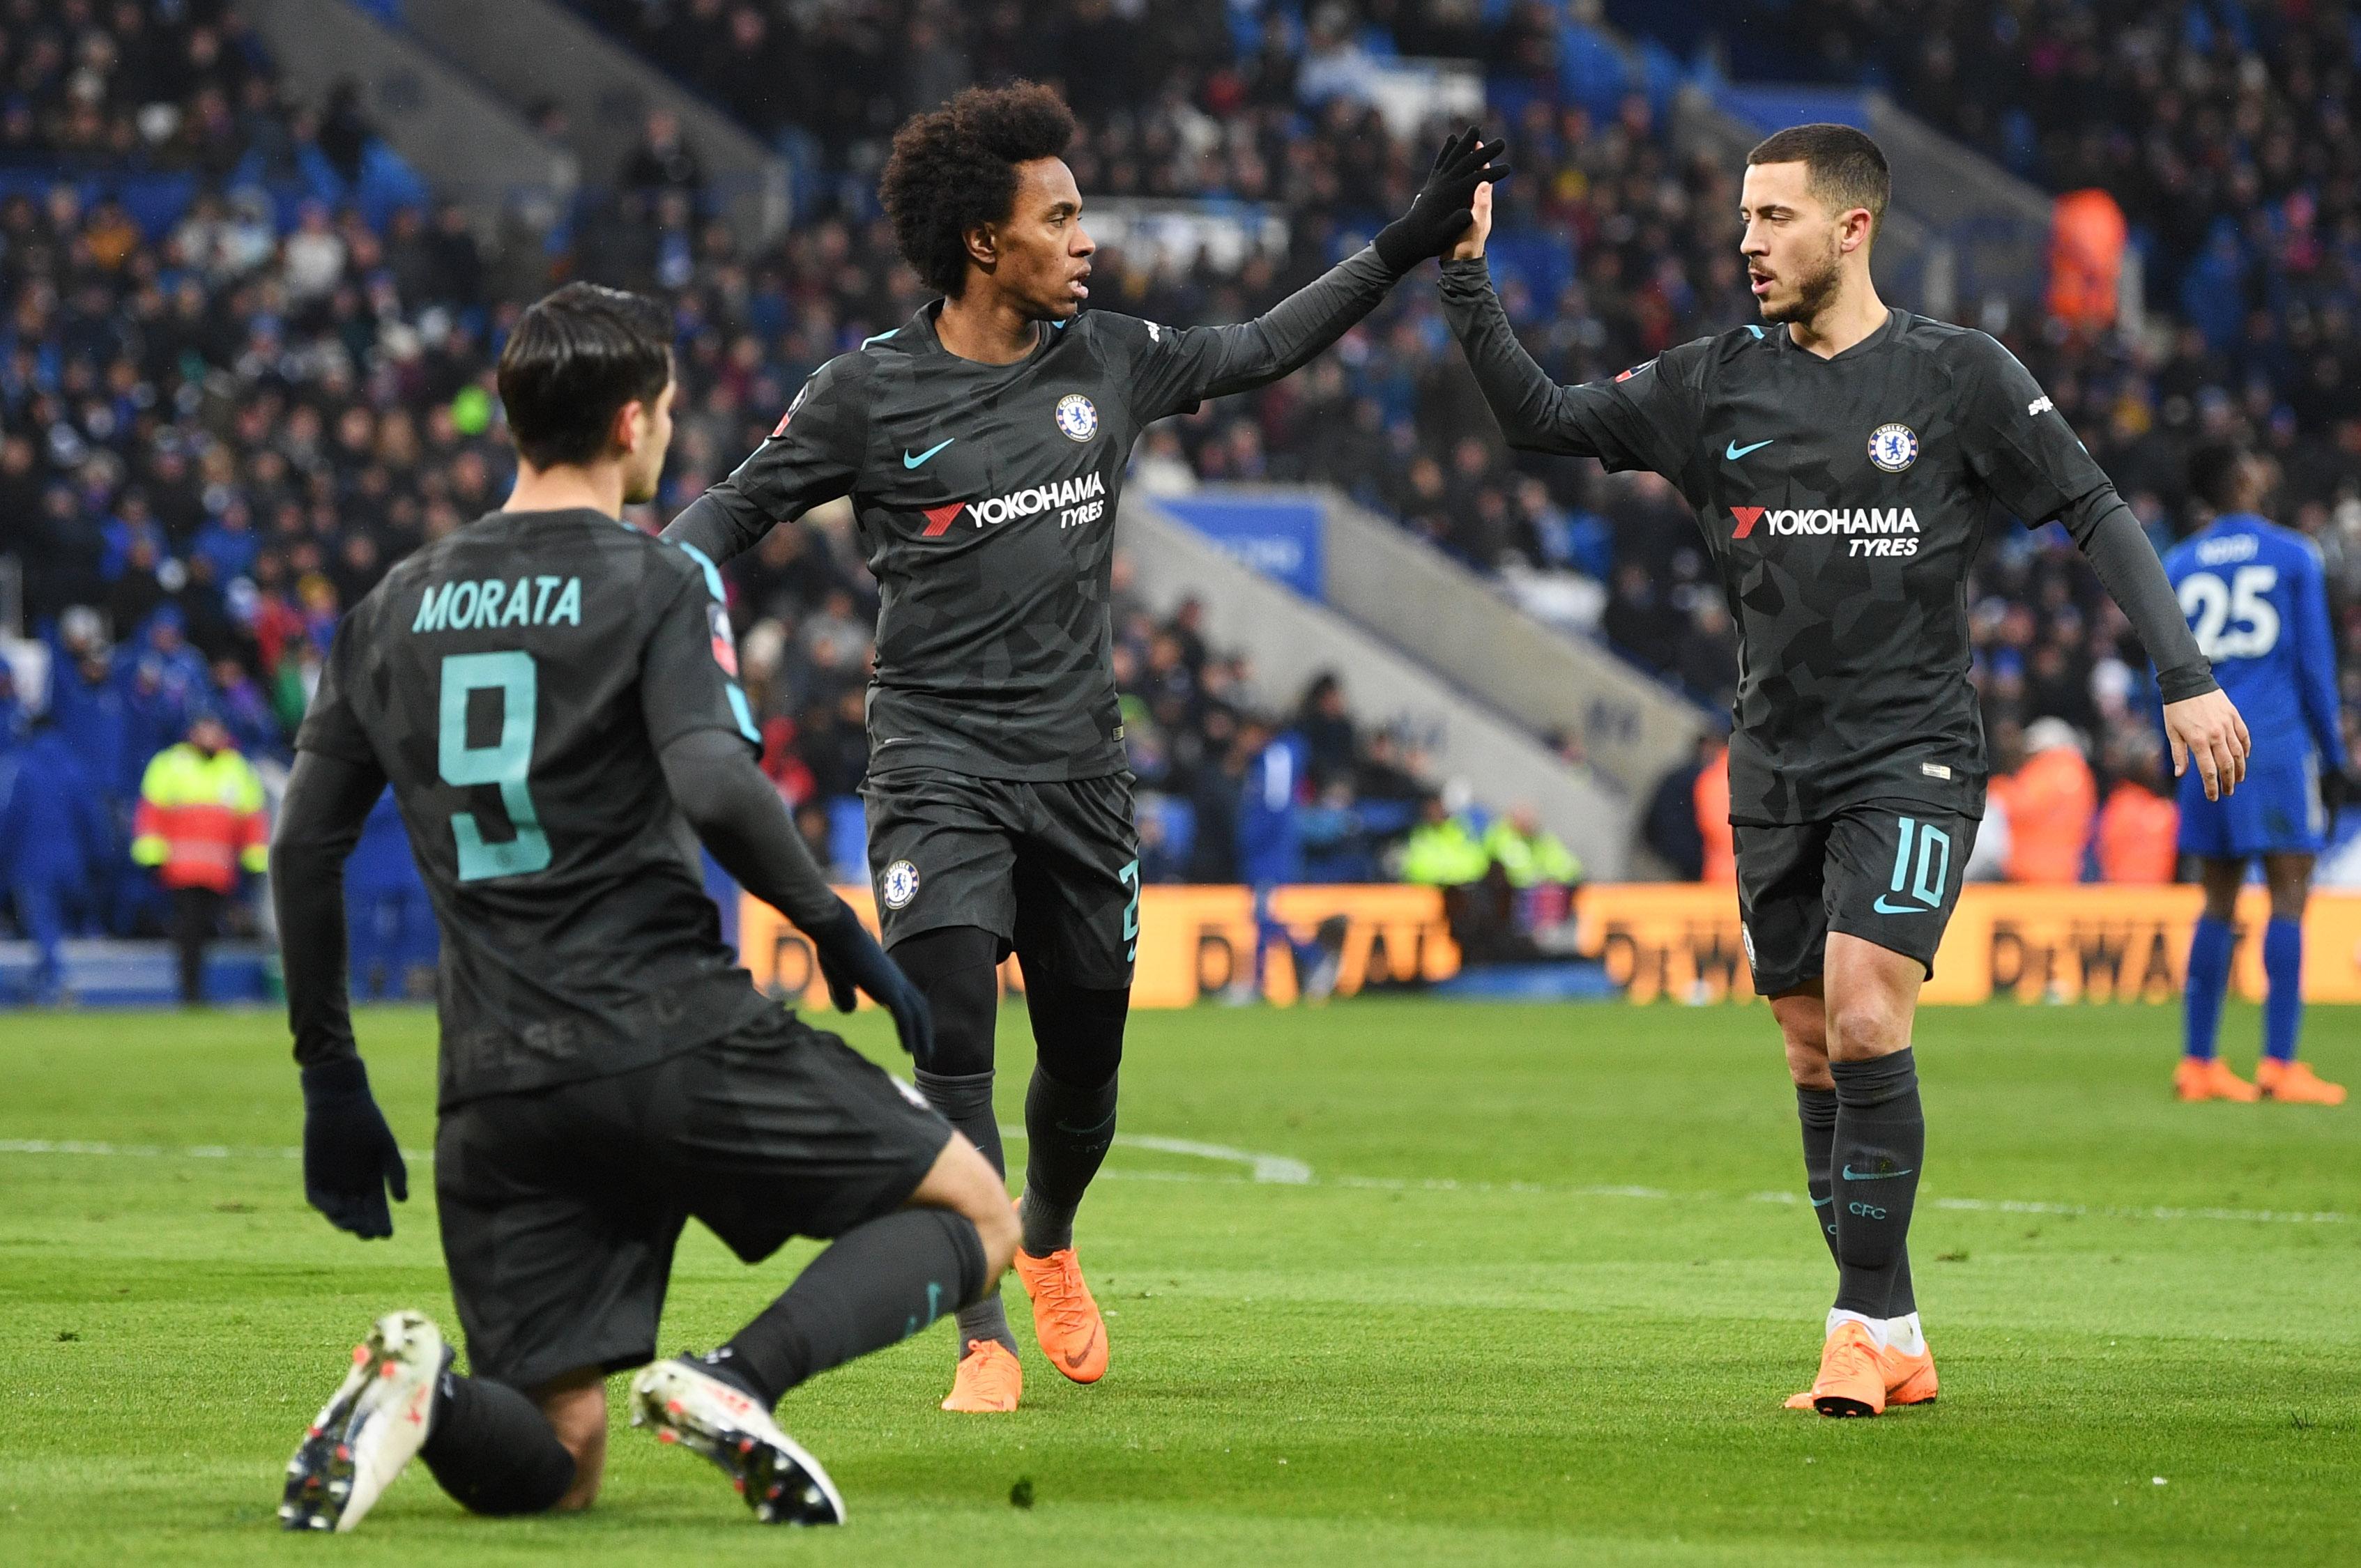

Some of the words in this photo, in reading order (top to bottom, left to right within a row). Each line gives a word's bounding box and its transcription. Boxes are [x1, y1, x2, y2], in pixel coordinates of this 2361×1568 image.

[1877, 425, 1909, 436] CHELSEA
[965, 470, 1106, 528] YOKOHAMA
[1061, 500, 1104, 529] TYRES
[1764, 507, 1920, 536] YOKOHAMA
[1849, 538, 1919, 557] TYRES
[412, 576, 581, 633] MORATA
[2176, 565, 2280, 662] 25
[438, 651, 551, 881] 9
[1890, 817, 1950, 908] 10
[1849, 1202, 1886, 1220] CFC
